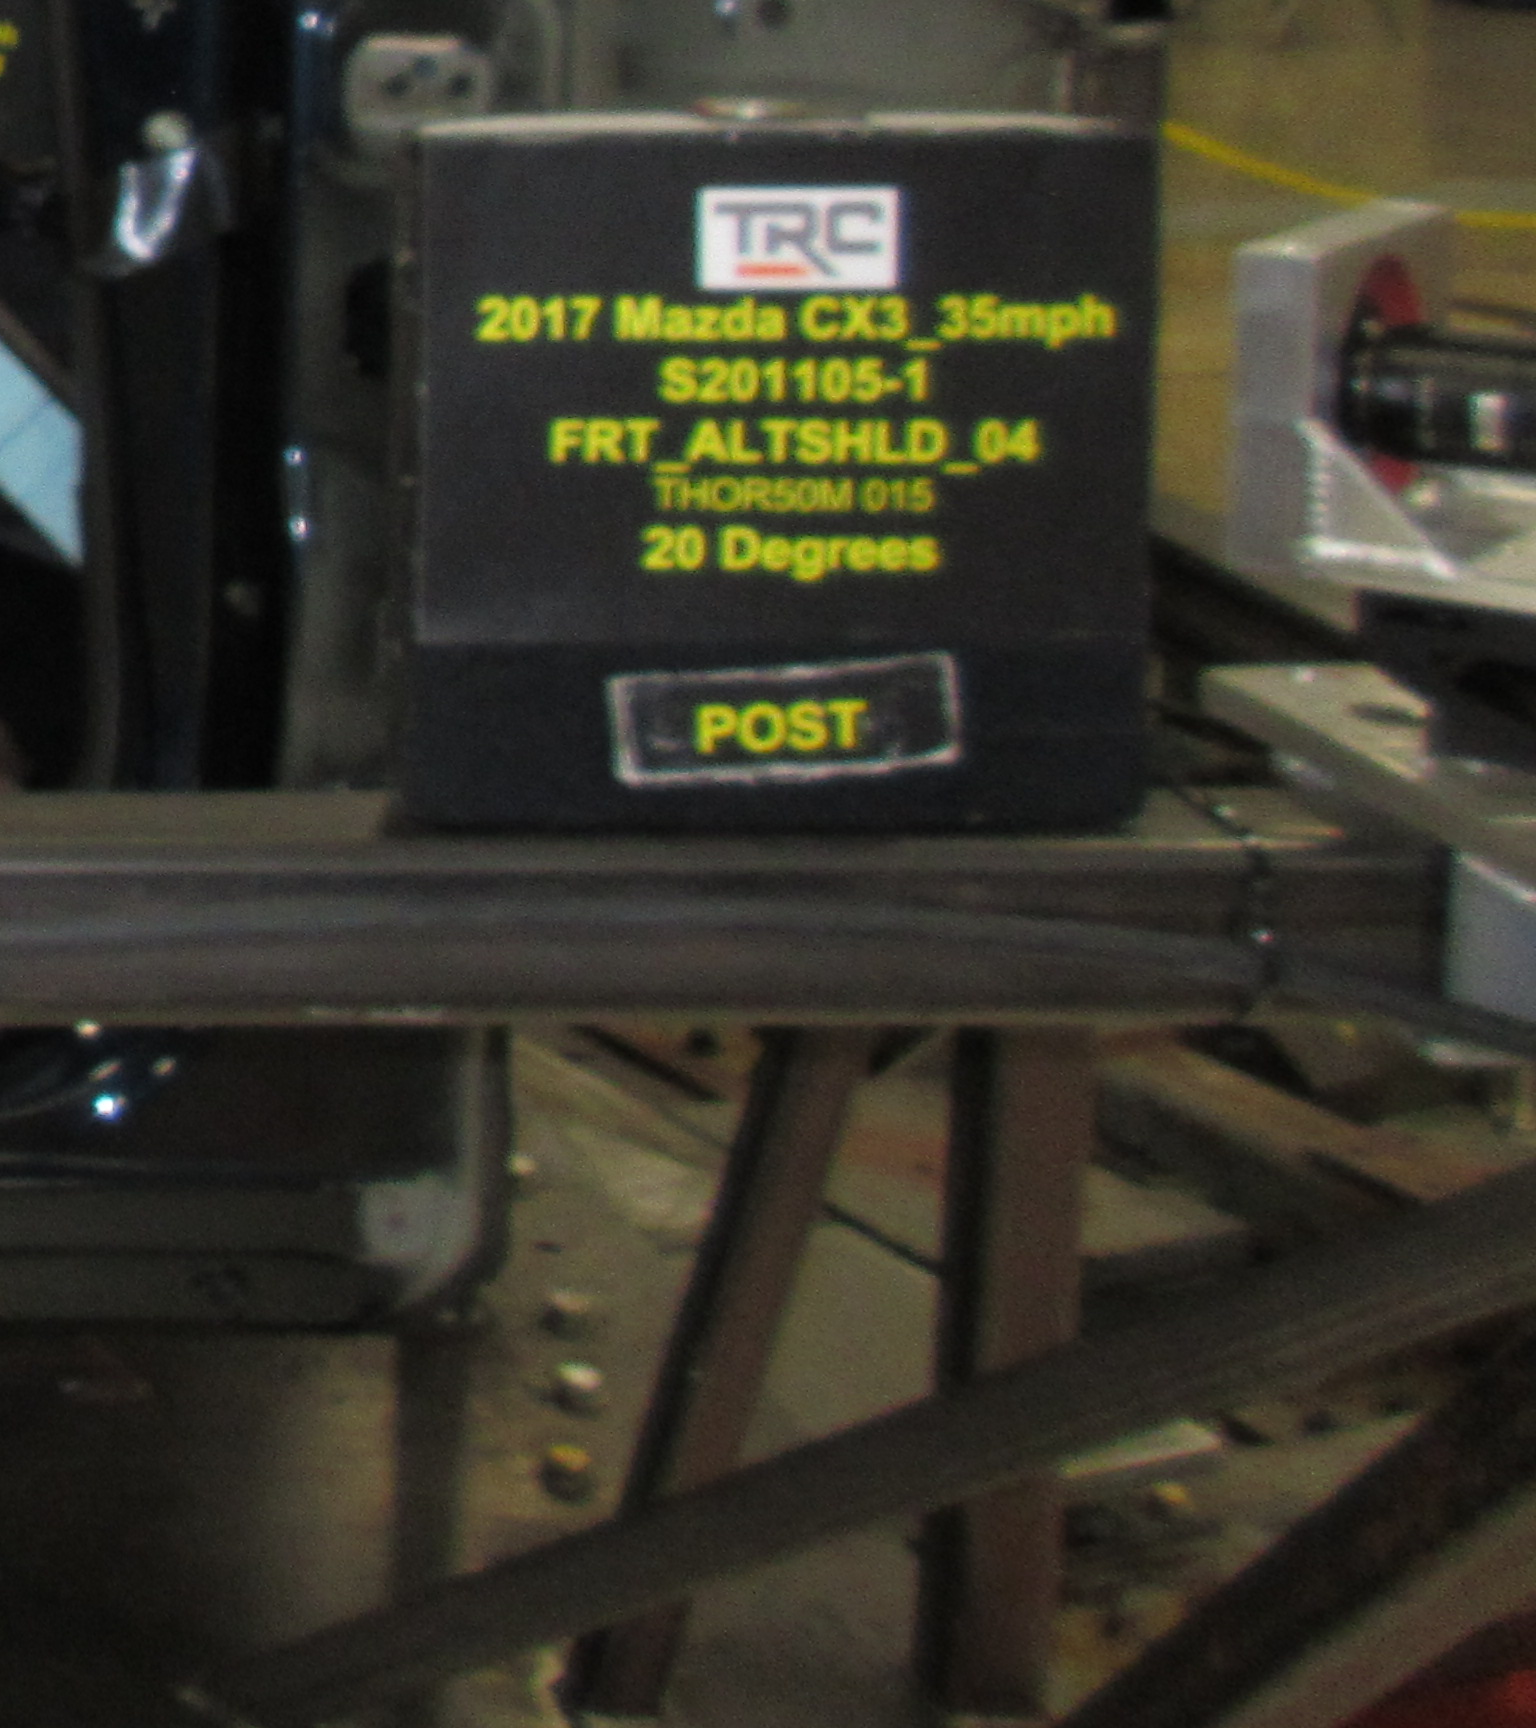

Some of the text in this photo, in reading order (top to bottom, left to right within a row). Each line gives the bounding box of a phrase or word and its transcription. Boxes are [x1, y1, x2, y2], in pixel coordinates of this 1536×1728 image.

[716, 202, 885, 276] TRC
[476, 293, 1118, 352] 2017 Mazda CX3_35mph
[659, 356, 930, 404] S201105-1
[549, 418, 1043, 473] FRT_ALTSHLD_04
[656, 476, 936, 513] THOR50M 015
[640, 524, 942, 583] 20 Degrees
[695, 700, 869, 754] POST
